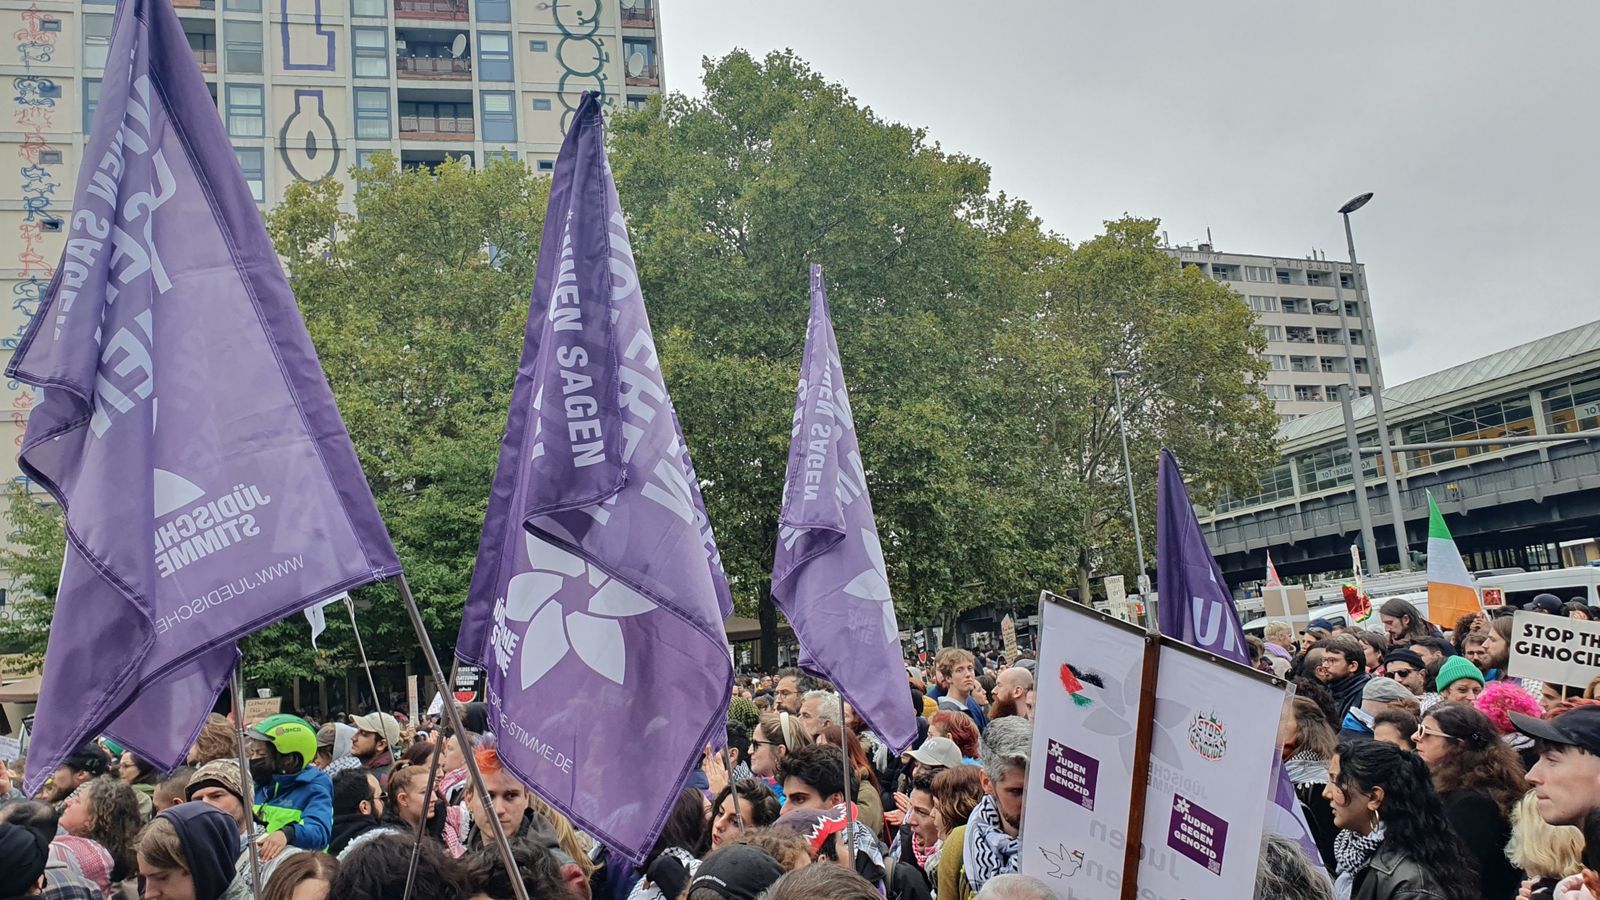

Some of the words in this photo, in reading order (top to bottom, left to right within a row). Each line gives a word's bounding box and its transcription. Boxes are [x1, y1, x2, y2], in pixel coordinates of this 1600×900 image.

[556, 345, 606, 468] SAGEN
[1523, 623, 1574, 643] STOP
[1055, 765, 1086, 785] GEGEN
[1056, 756, 1086, 775] JUDEN
[1049, 773, 1090, 796] GENOZID
[1180, 823, 1213, 847] GEGEN
[1182, 813, 1214, 836] JUDEN
[1174, 830, 1217, 859] GENOZID
